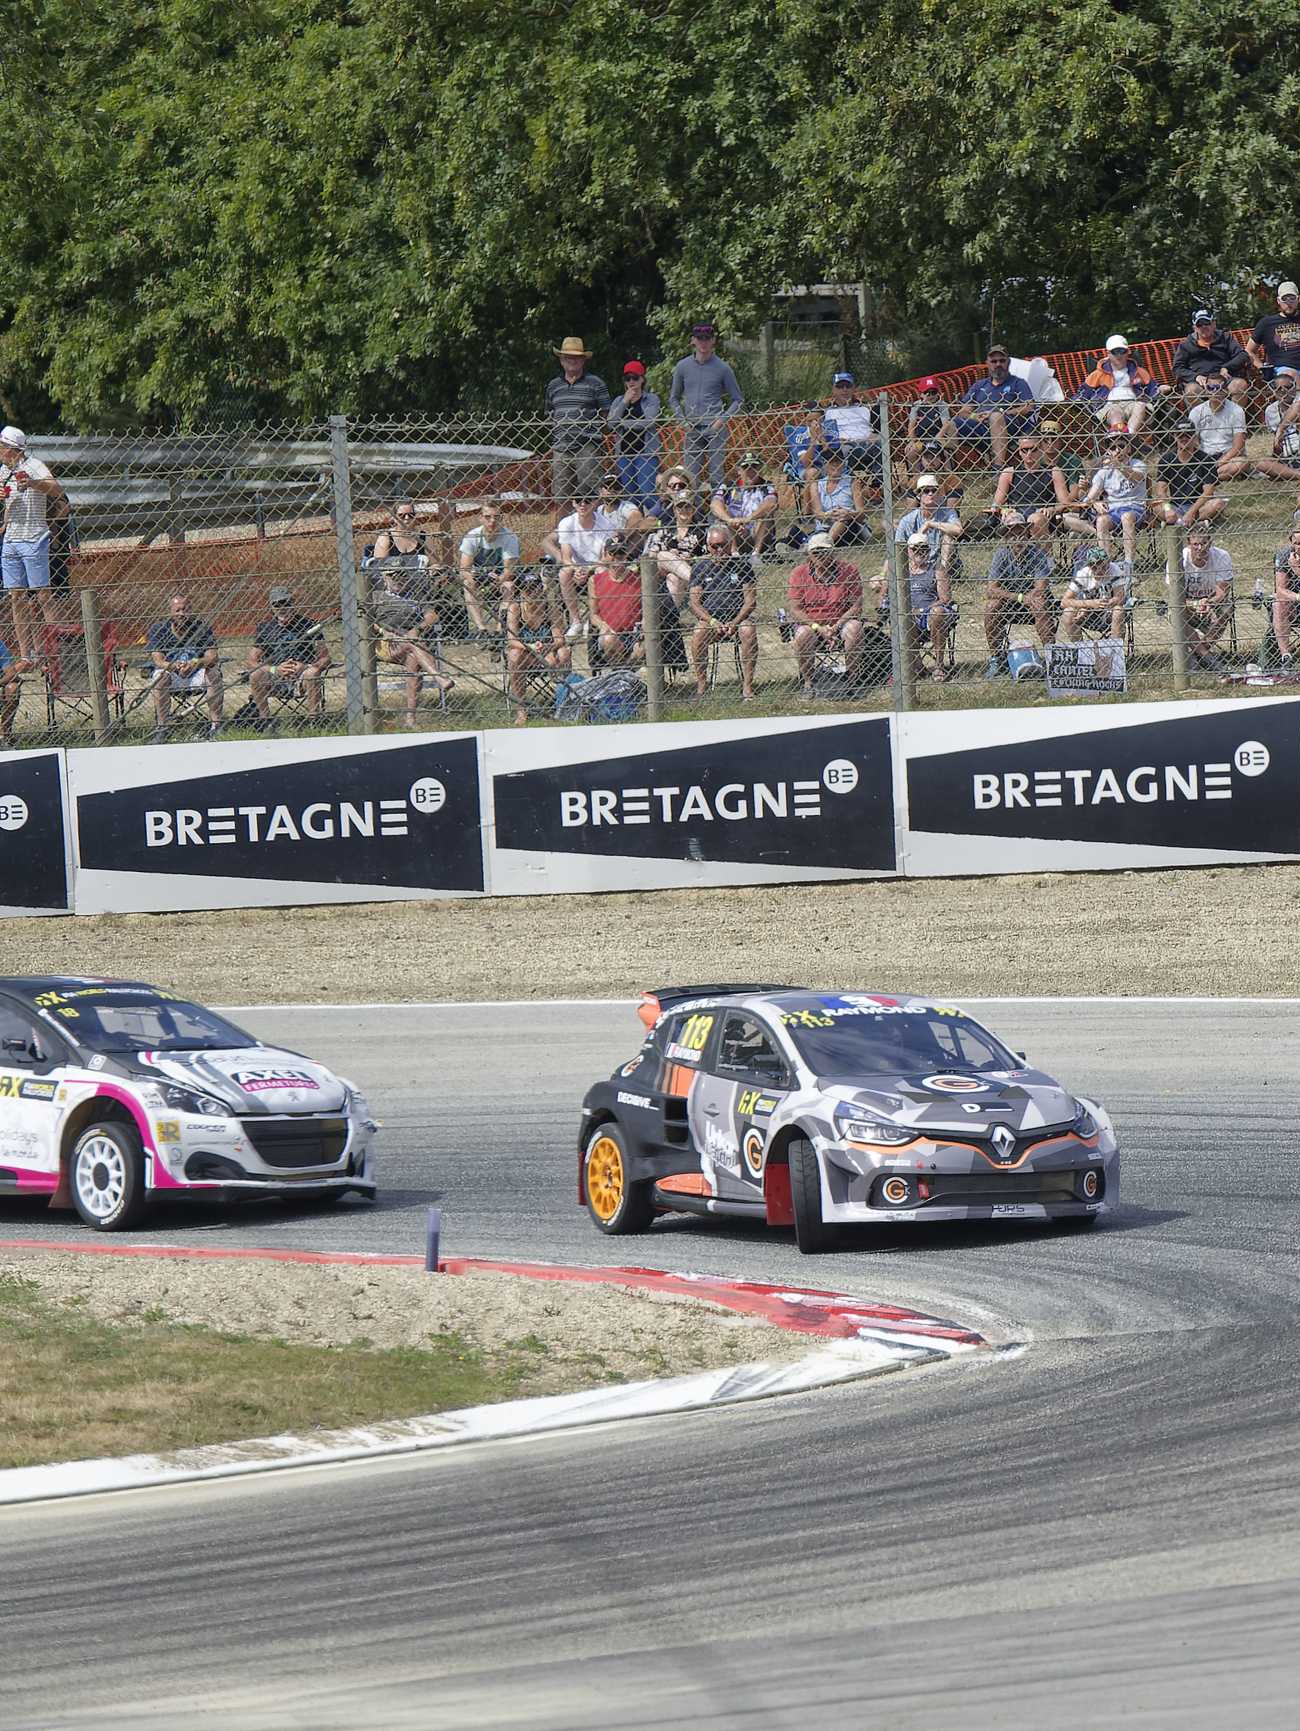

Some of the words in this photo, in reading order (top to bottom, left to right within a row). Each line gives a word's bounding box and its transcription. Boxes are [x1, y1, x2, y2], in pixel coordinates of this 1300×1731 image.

[560, 781, 820, 826] BRETAGNE
[973, 764, 1232, 809] BRETAGNE
[145, 799, 408, 846] BRETAGNE
[681, 1014, 713, 1049] 113
[804, 1015, 836, 1028] 113
[822, 1006, 928, 1018] RAYMOND
